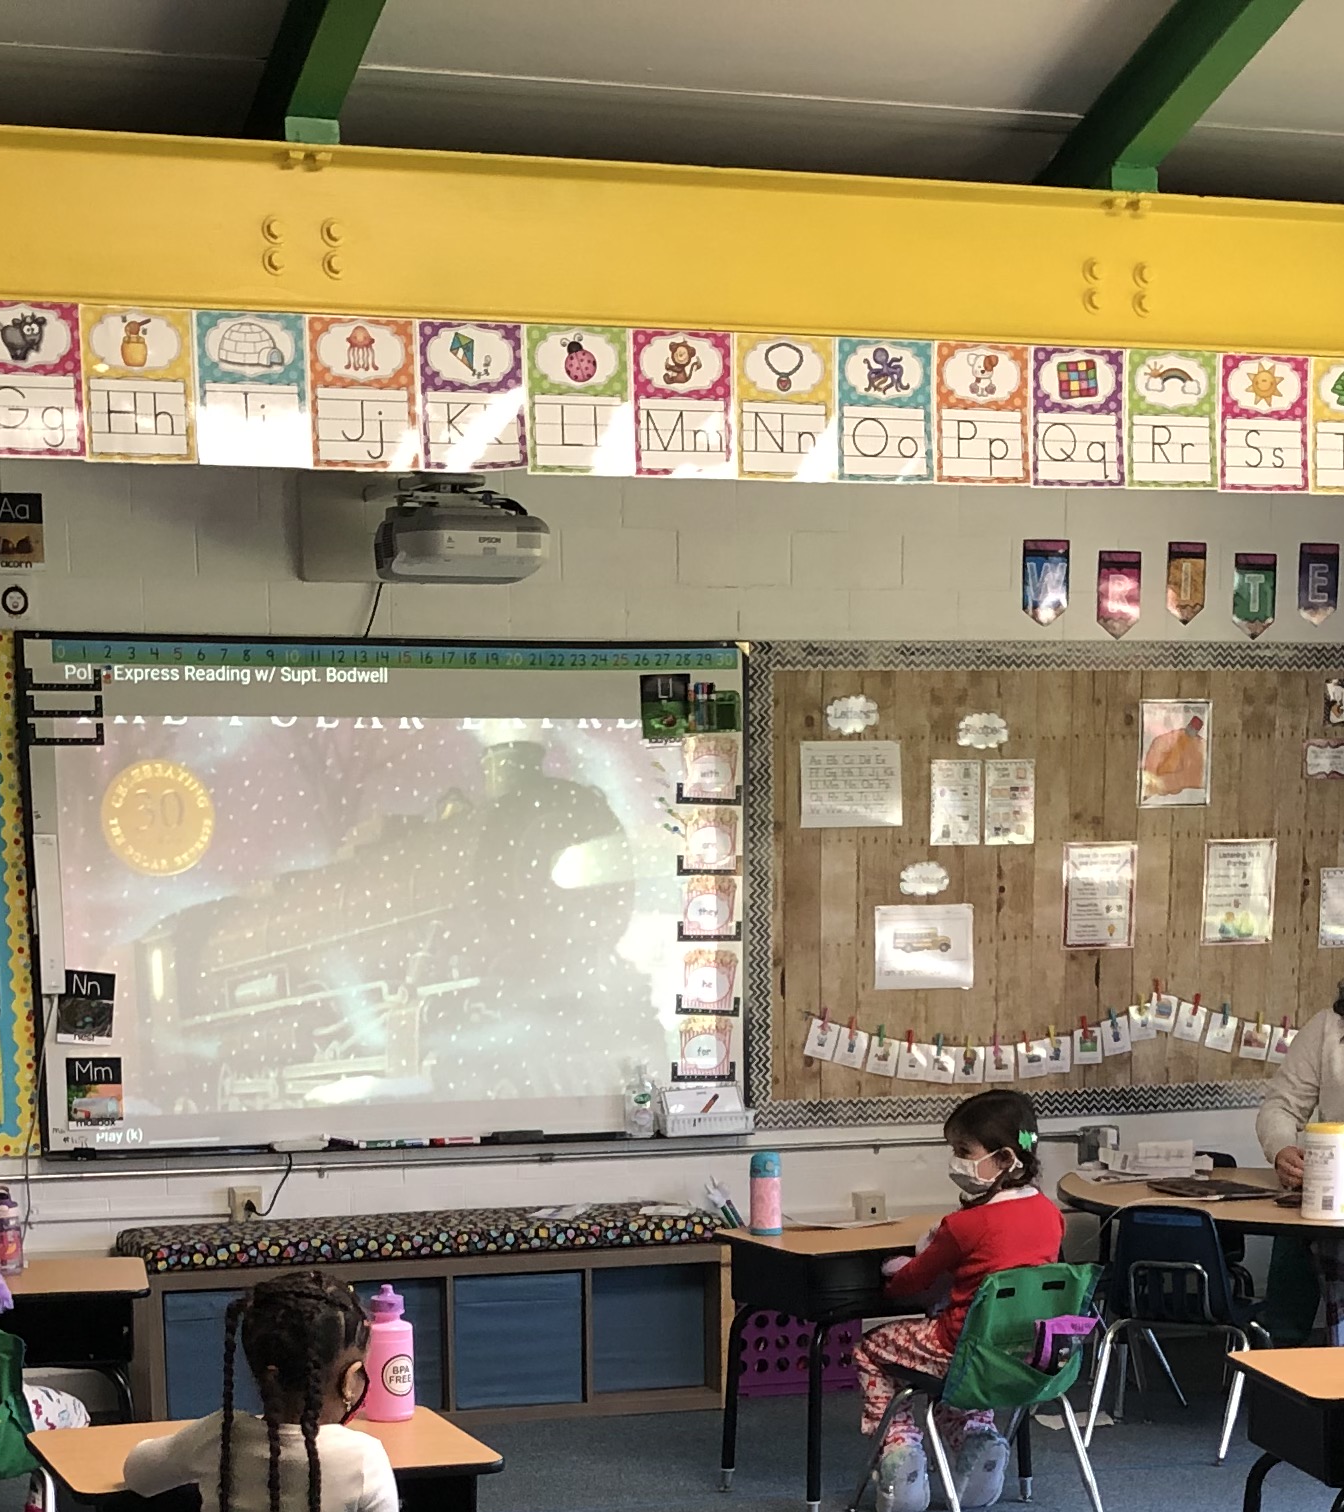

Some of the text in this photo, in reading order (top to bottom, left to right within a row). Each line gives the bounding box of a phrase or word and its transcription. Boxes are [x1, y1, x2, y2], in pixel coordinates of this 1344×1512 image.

[107, 391, 174, 435] Hh
[342, 400, 384, 459] Jj
[561, 405, 599, 447] Ll
[646, 410, 724, 453] Mm
[755, 412, 816, 454] Nn
[852, 417, 919, 459] Oo
[957, 420, 1009, 477] Pp
[1151, 424, 1195, 464] Rr
[1245, 429, 1284, 469] Ss
[1042, 422, 1109, 479] Qq
[478, 536, 501, 544] EPSON
[104, 646, 112, 659] 2
[221, 648, 228, 661] 7
[331, 650, 345, 663] 12
[570, 653, 586, 667] 23
[676, 653, 691, 666] 28
[65, 664, 389, 687] Pol Express Reading w/ Supt. Bodwell
[73, 974, 101, 996] Nn
[697, 1047, 711, 1056] for
[75, 1061, 113, 1082] Mm
[126, 1128, 144, 1144] (k)
[388, 1373, 412, 1385] FREE
[392, 1365, 410, 1375] BPA
